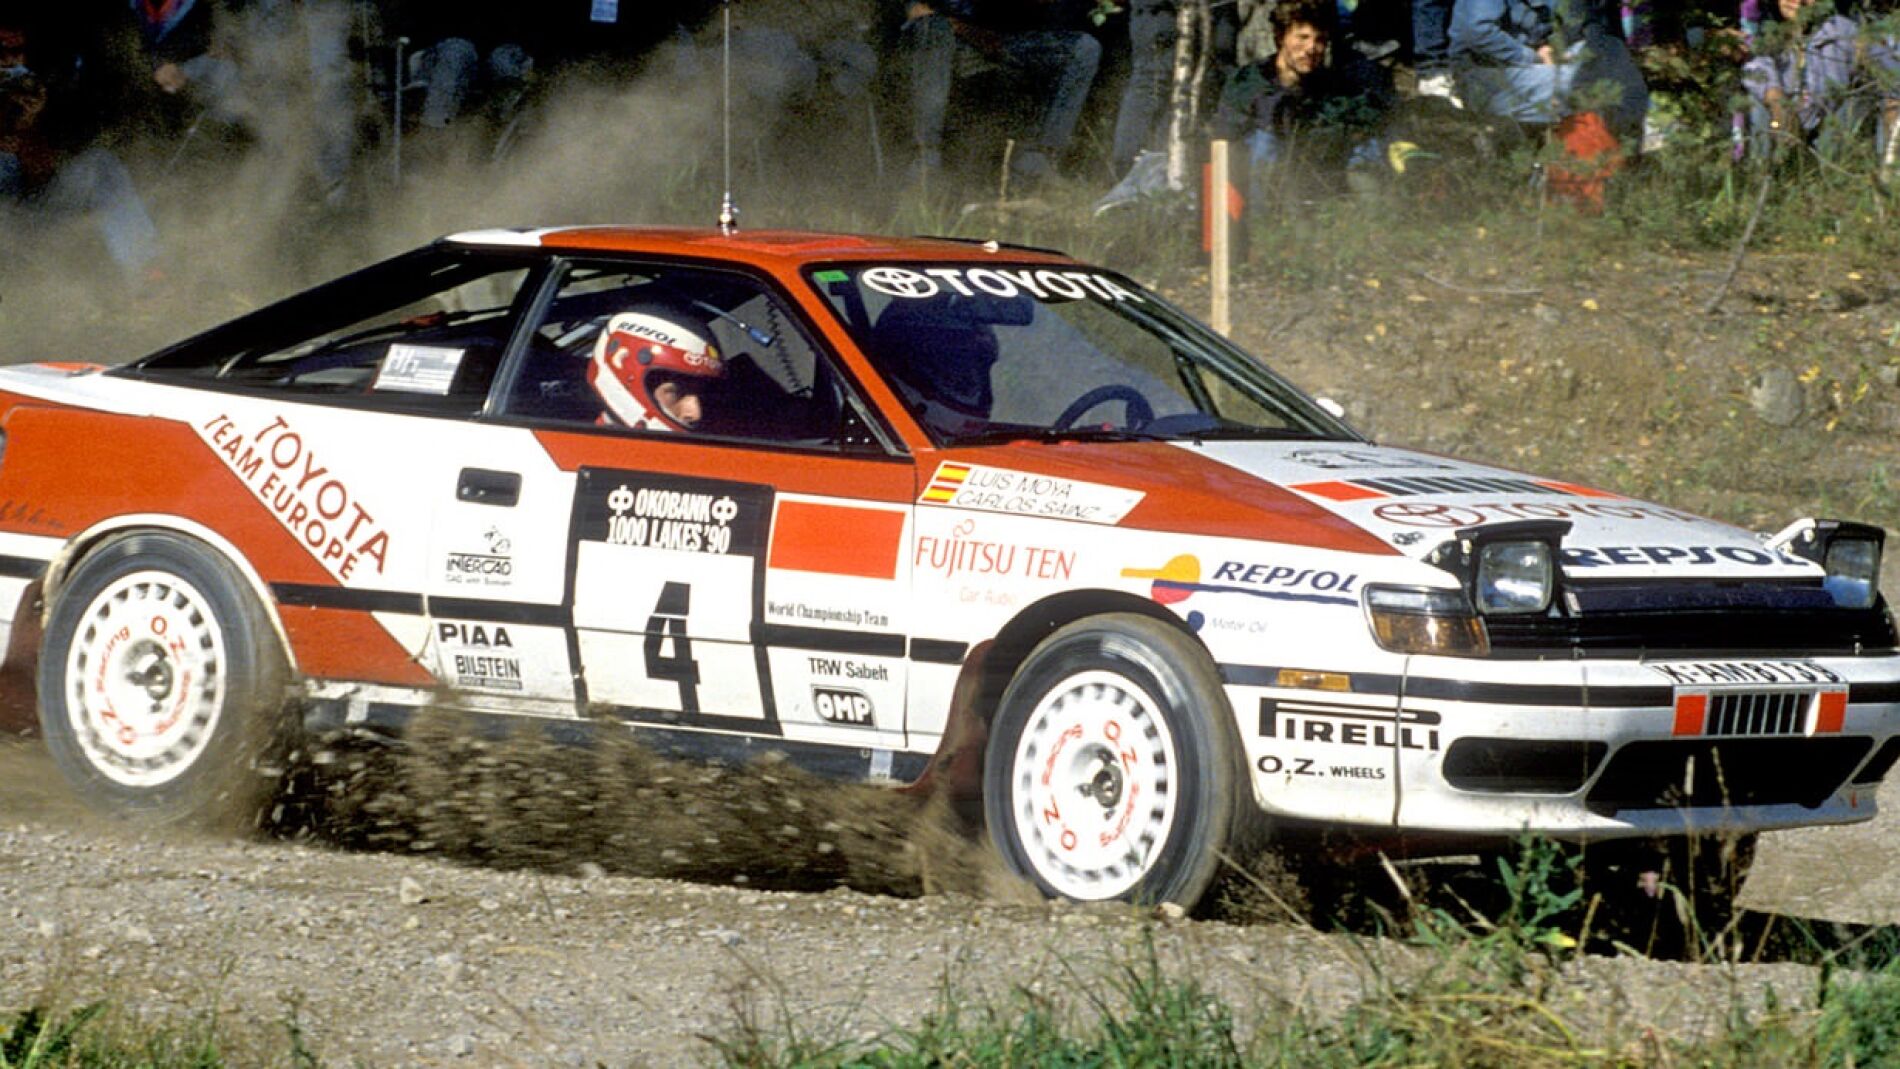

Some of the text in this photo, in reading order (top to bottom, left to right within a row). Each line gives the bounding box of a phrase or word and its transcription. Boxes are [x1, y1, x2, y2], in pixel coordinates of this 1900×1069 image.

[925, 268, 1144, 303] TOYOTA
[204, 414, 358, 579] TEAM EUROPE
[255, 415, 389, 574] TOYOTA
[969, 469, 1073, 498] LUIS MOYA
[634, 488, 714, 523] OKOBANK
[956, 490, 1038, 512] CARLOS
[607, 515, 649, 546] 1000
[649, 519, 702, 552] LAKES
[916, 535, 1076, 580] FUJITSU TEN
[1212, 561, 1358, 592] REPSOL
[767, 601, 889, 627] World Championship Team
[439, 623, 513, 648] PIAA
[643, 580, 701, 713] 4
[455, 655, 521, 678] BILSTEIN
[809, 656, 889, 681] TRW Sabelt
[816, 692, 872, 723] OMP
[1258, 697, 1442, 751] PIRELLI
[1329, 765, 1387, 780] WHEELS
